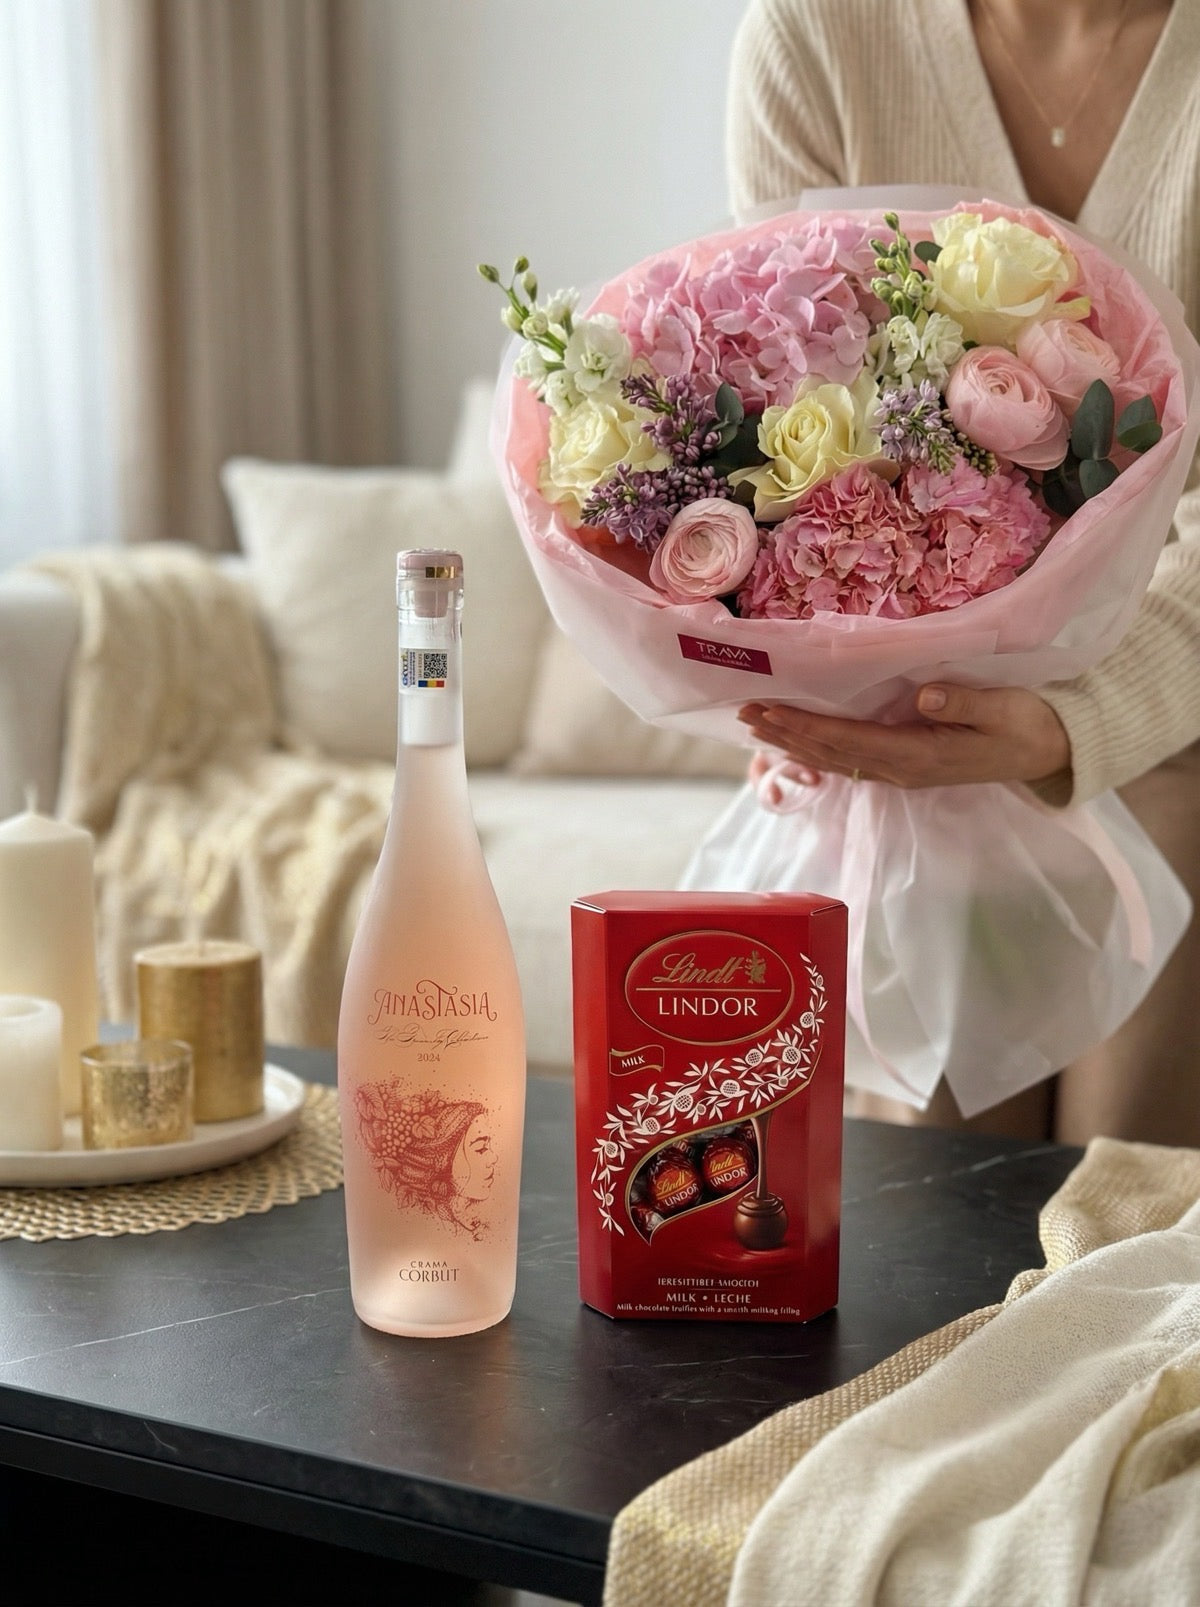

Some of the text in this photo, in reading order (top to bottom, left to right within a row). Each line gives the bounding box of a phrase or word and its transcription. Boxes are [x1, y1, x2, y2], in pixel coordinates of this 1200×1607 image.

[696, 641, 752, 661] TRAVA
[652, 953, 745, 984] Lindt
[367, 979, 498, 1025] ANASTASIA
[658, 997, 759, 1017] LINDOR
[417, 1053, 441, 1062] 2024
[621, 1055, 646, 1068] MILK
[399, 1268, 460, 1282] CORBUT
[666, 1293, 752, 1304] MILK LECHE
[616, 1303, 633, 1311] Milk
[634, 1303, 669, 1312] chocolate
